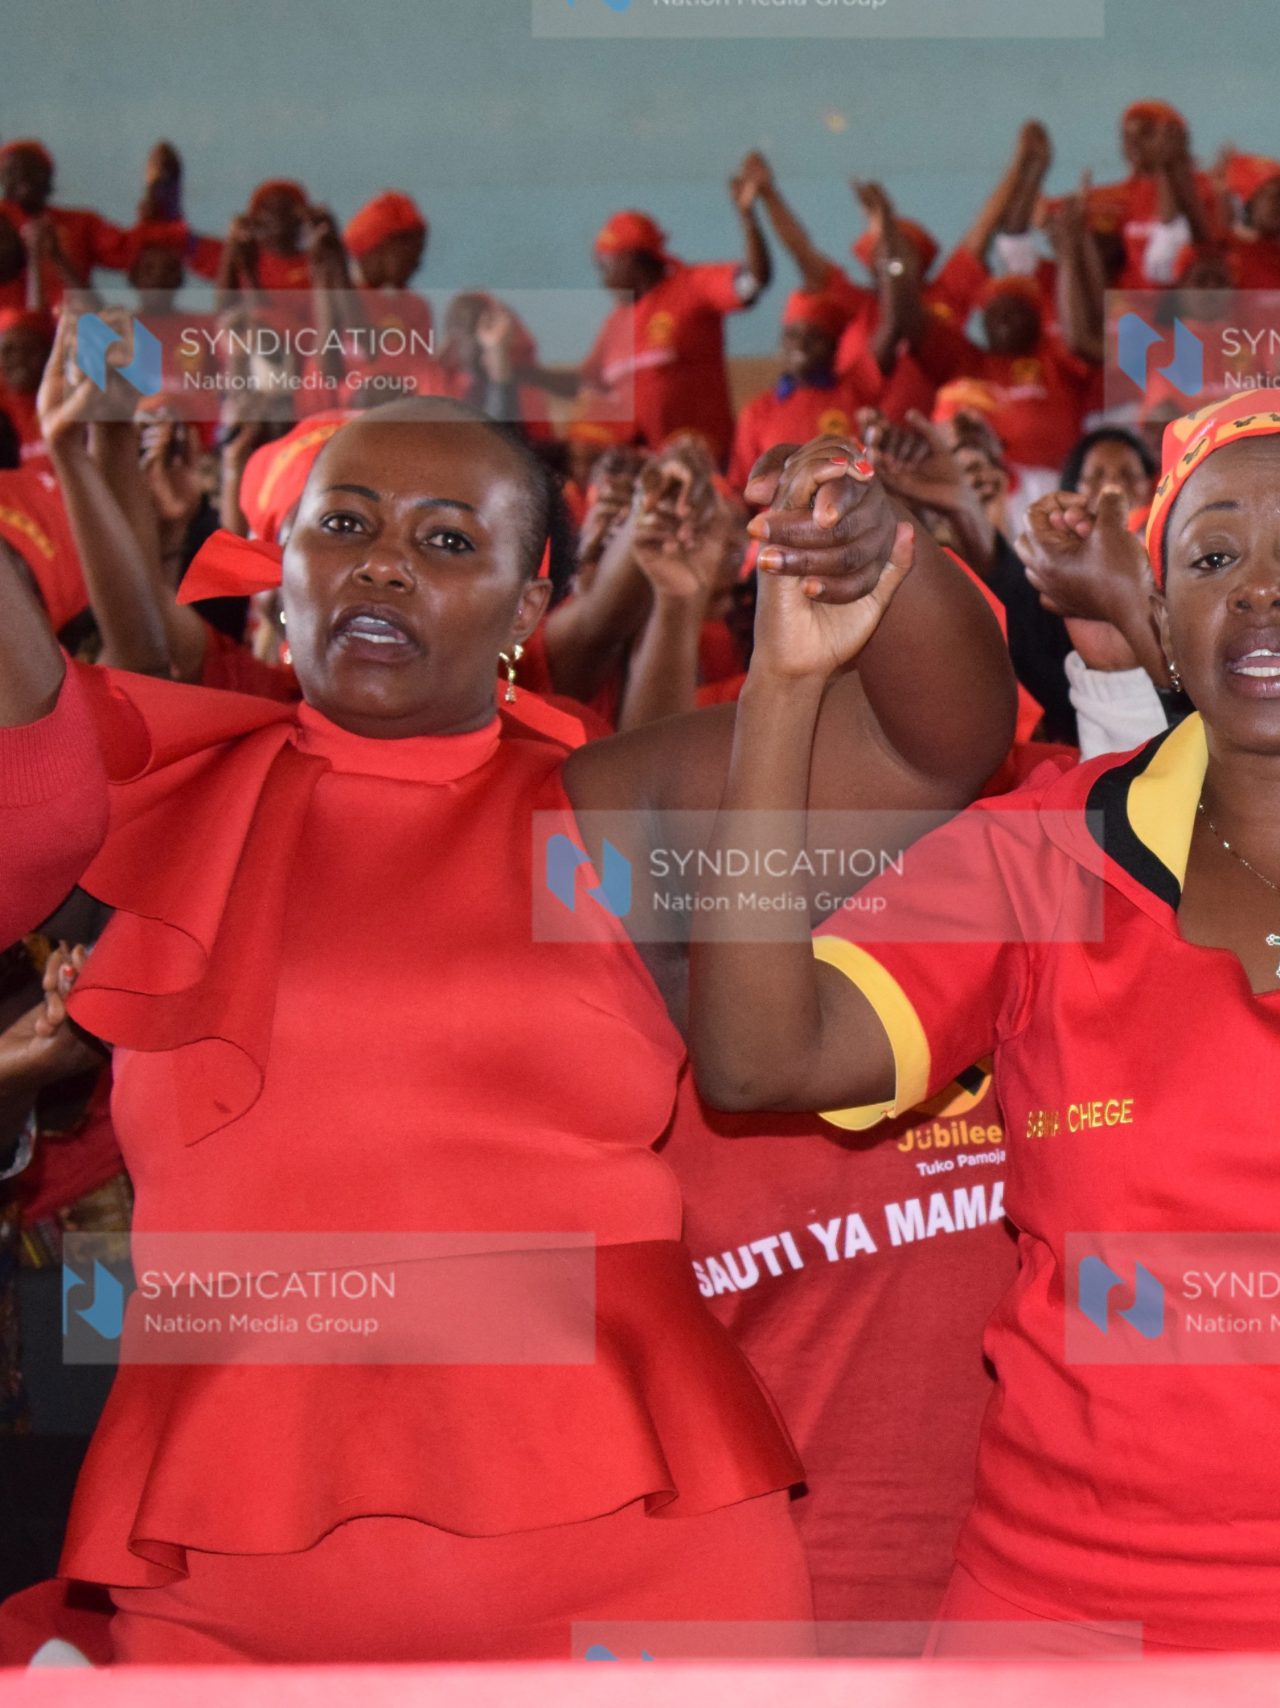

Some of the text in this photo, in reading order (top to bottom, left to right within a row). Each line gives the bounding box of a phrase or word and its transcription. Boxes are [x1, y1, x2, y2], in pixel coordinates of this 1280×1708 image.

[1067, 1098, 1135, 1133] CHEGE
[897, 1120, 1004, 1152] Jubilee
[916, 1160, 955, 1176] Tuko
[692, 1231, 804, 1298] SAUTI
[807, 1213, 878, 1262] YA
